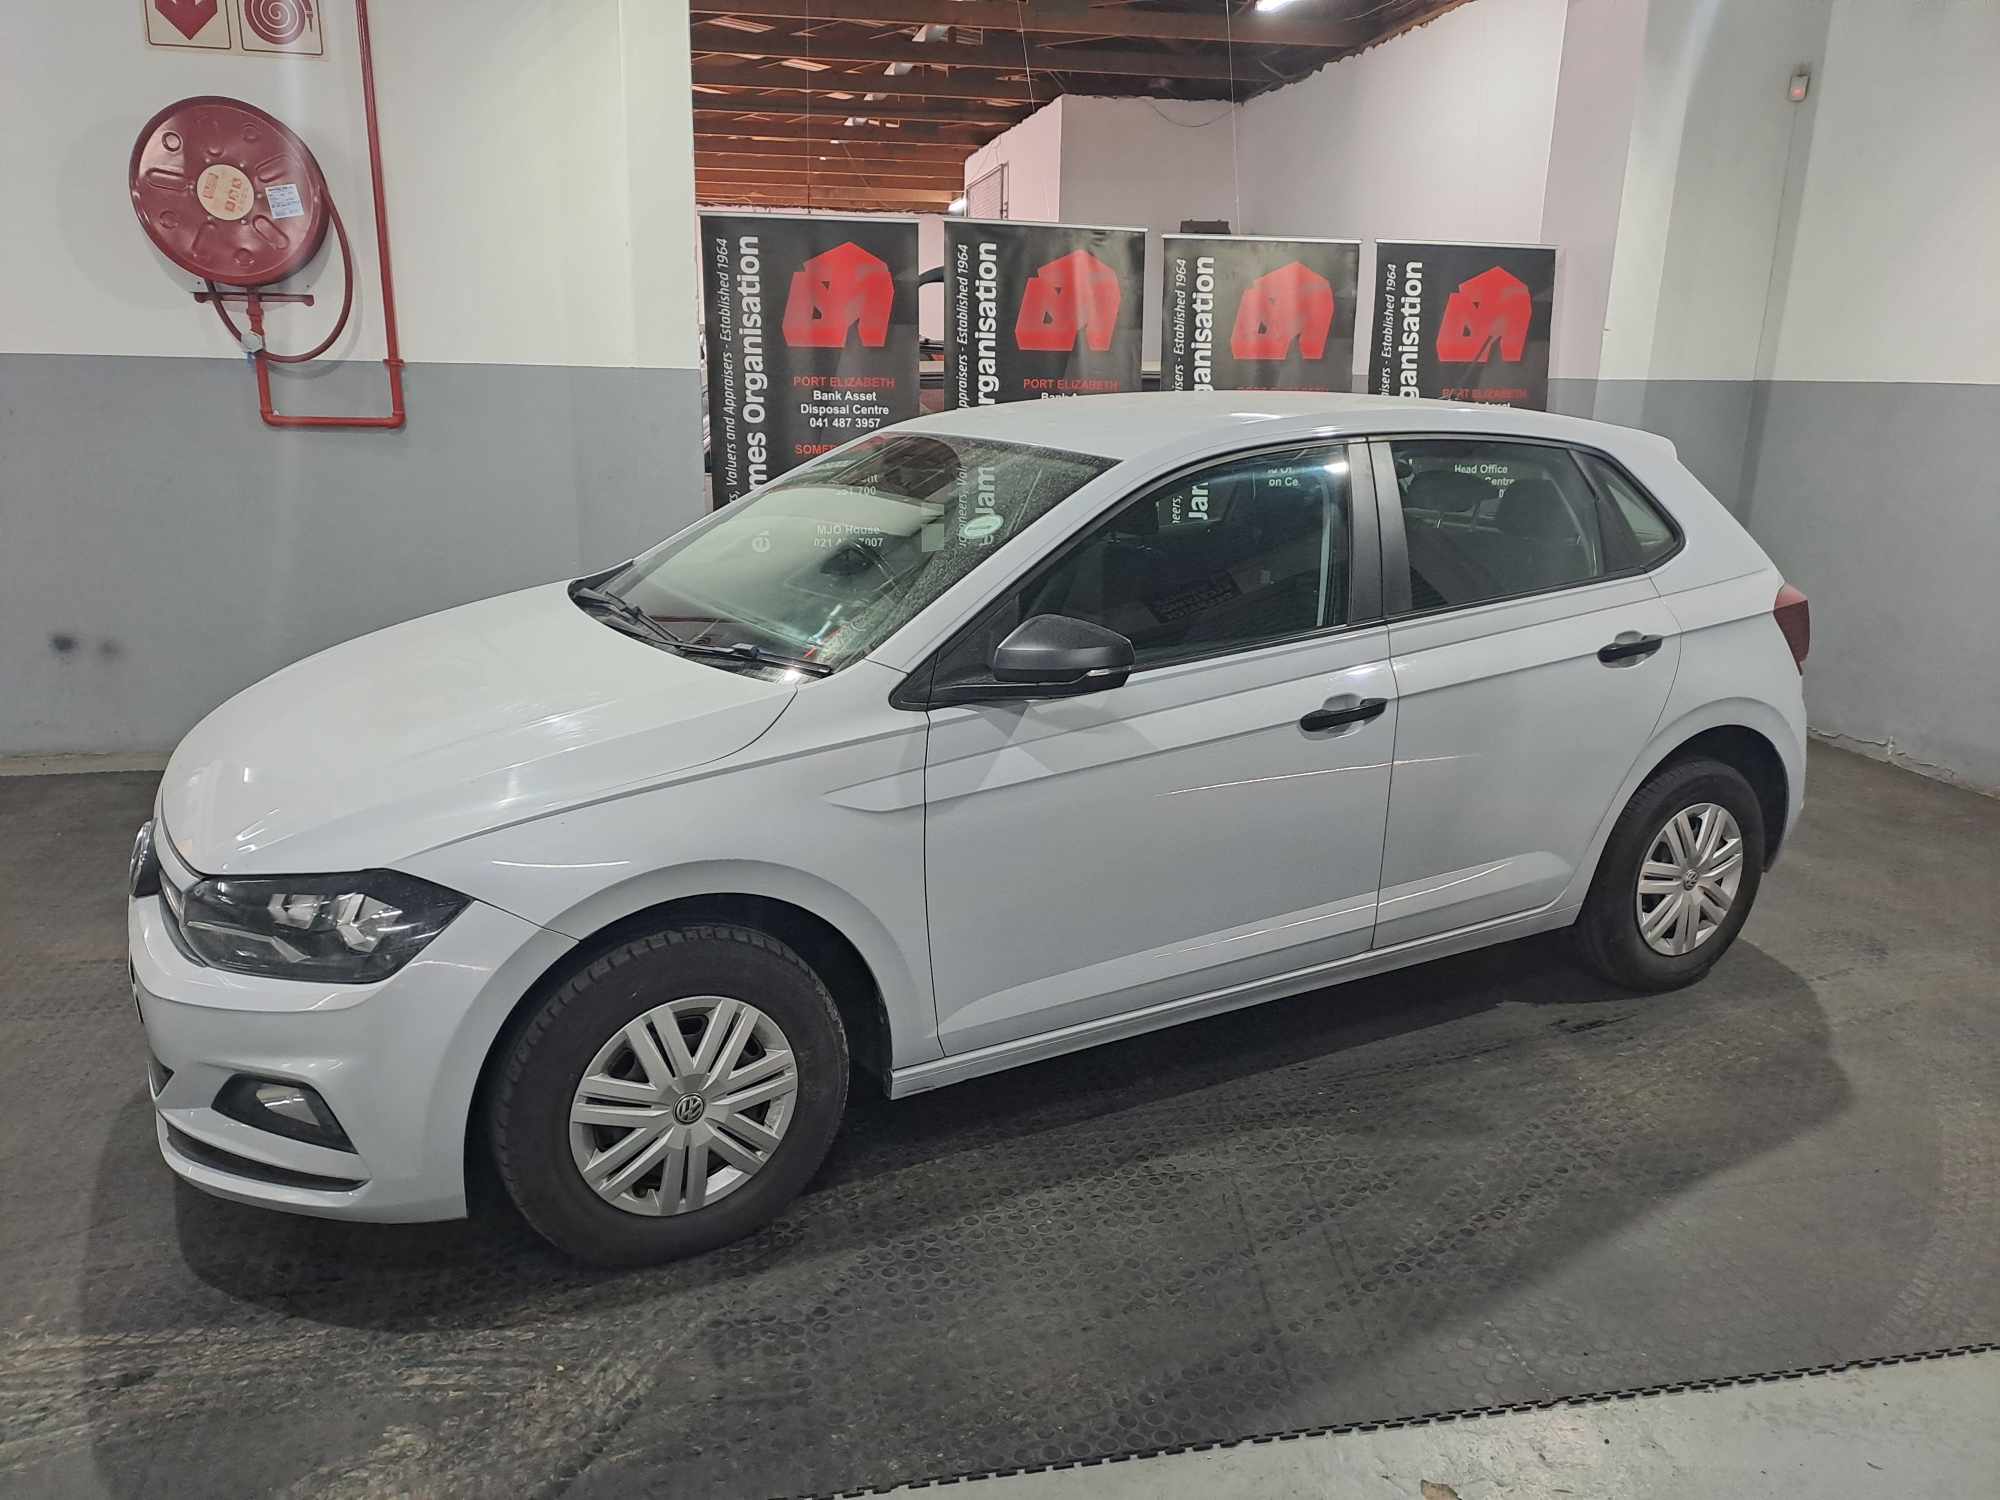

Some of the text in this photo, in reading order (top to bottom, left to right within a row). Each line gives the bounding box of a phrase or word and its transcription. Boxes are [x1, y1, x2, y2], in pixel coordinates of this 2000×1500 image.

[716, 238, 729, 268] 1964
[957, 244, 969, 274] 1964
[1174, 258, 1187, 288] 1964
[1386, 263, 1397, 292] 1964
[717, 272, 732, 341] Established
[956, 276, 969, 344] Established
[1172, 290, 1186, 354] Established
[1381, 294, 1395, 358] Established
[721, 352, 736, 414] Appraisers
[793, 376, 896, 388] PORT ELIZABETH
[813, 391, 877, 401] Bank Asset
[1024, 379, 1053, 389] PORT
[800, 404, 890, 416] Disposal Centre
[809, 418, 881, 428] 041 487 3957
[723, 416, 736, 440] and
[725, 442, 738, 486] Valuers
[1454, 464, 1508, 474] Head Office
